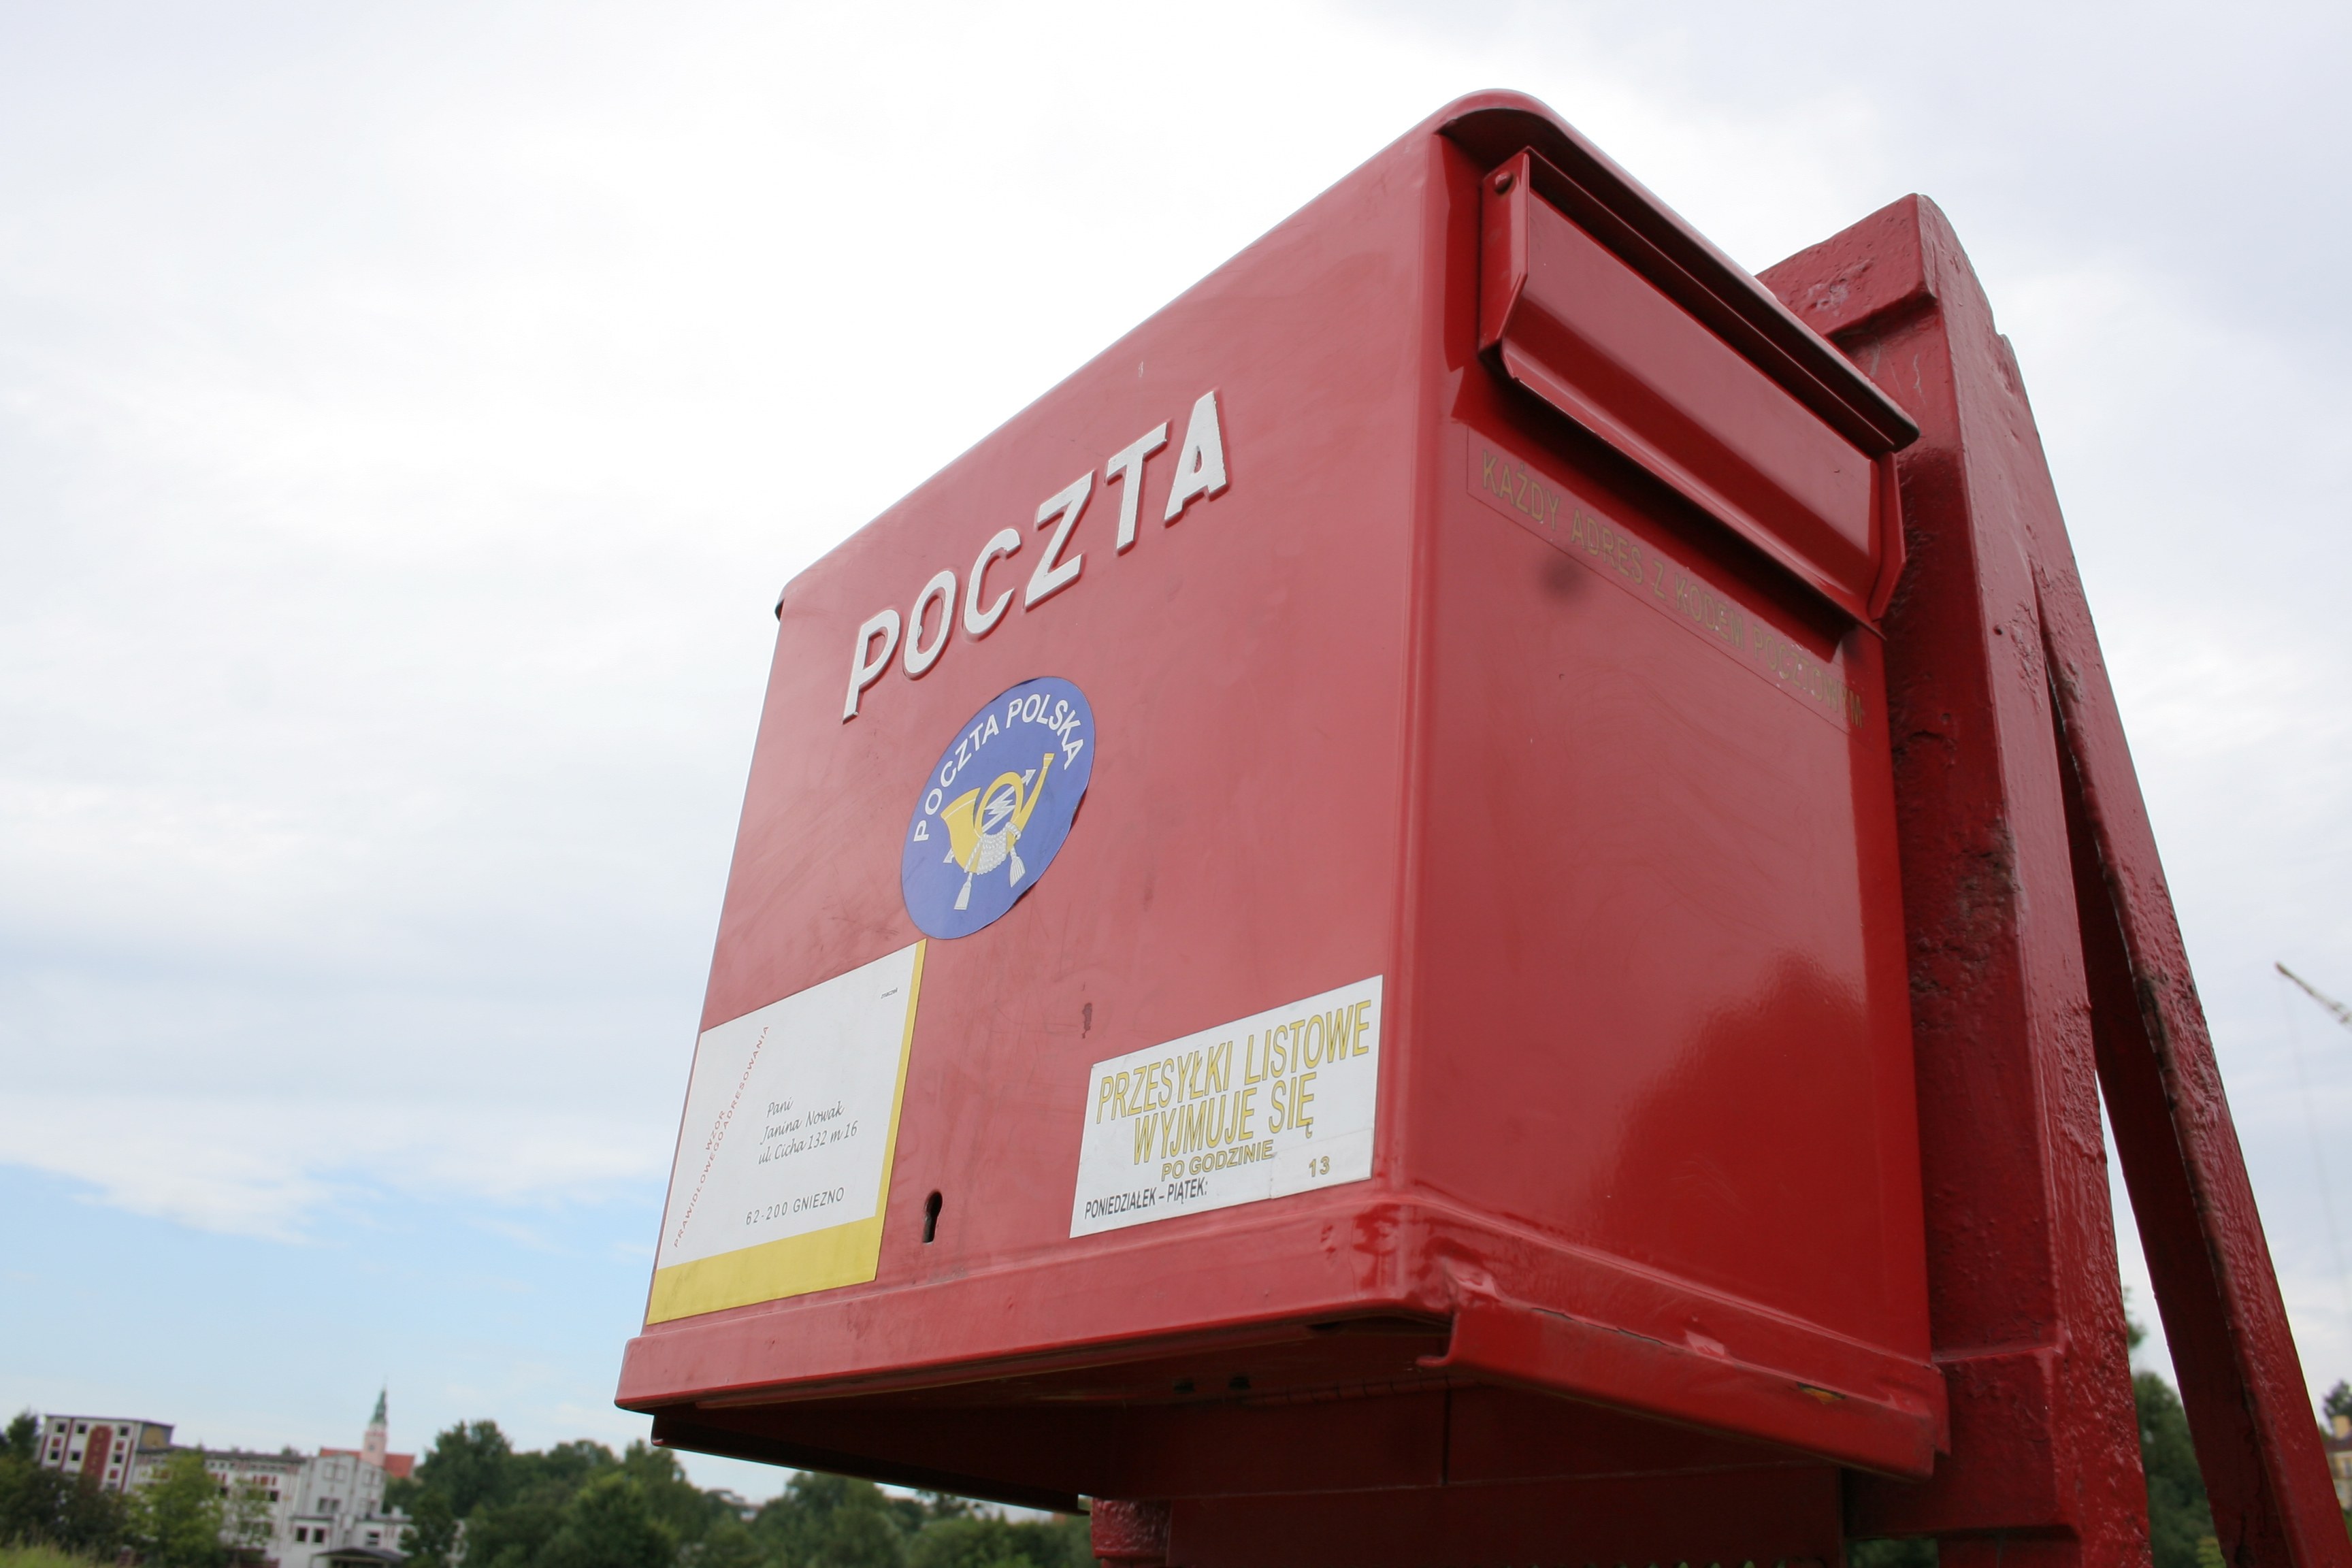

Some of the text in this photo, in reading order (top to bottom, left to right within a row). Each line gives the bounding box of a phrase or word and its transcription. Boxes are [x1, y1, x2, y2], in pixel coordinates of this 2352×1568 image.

[843, 390, 1227, 725] POCZTA
[1483, 449, 1560, 530] KAŻDY
[1571, 508, 1644, 585] ADRES
[1653, 559, 1667, 600] Z
[1675, 572, 1744, 651] KODEM
[913, 693, 1083, 841] POCZTA POLSKA
[1096, 1000, 1371, 1124] PRZESYŁKI LISTOWE
[674, 1026, 769, 1247] PRAWIDŁOWEGO ADRESOWANIA
[758, 1120, 858, 1164] ul. Cicha 132 m 16
[760, 1100, 846, 1145] Janina Nowak
[766, 1096, 794, 1118] Pani
[1133, 1072, 1317, 1165] WYJMUJE SIĘ
[1084, 1186, 1157, 1220] PONIEDZIAŁEK
[1166, 1177, 1209, 1205] PIĄTEK:
[1308, 1156, 1330, 1177] 13
[1161, 1139, 1275, 1181] PO GODZINIE
[746, 1187, 845, 1226] 62-200 GNIEZNO
